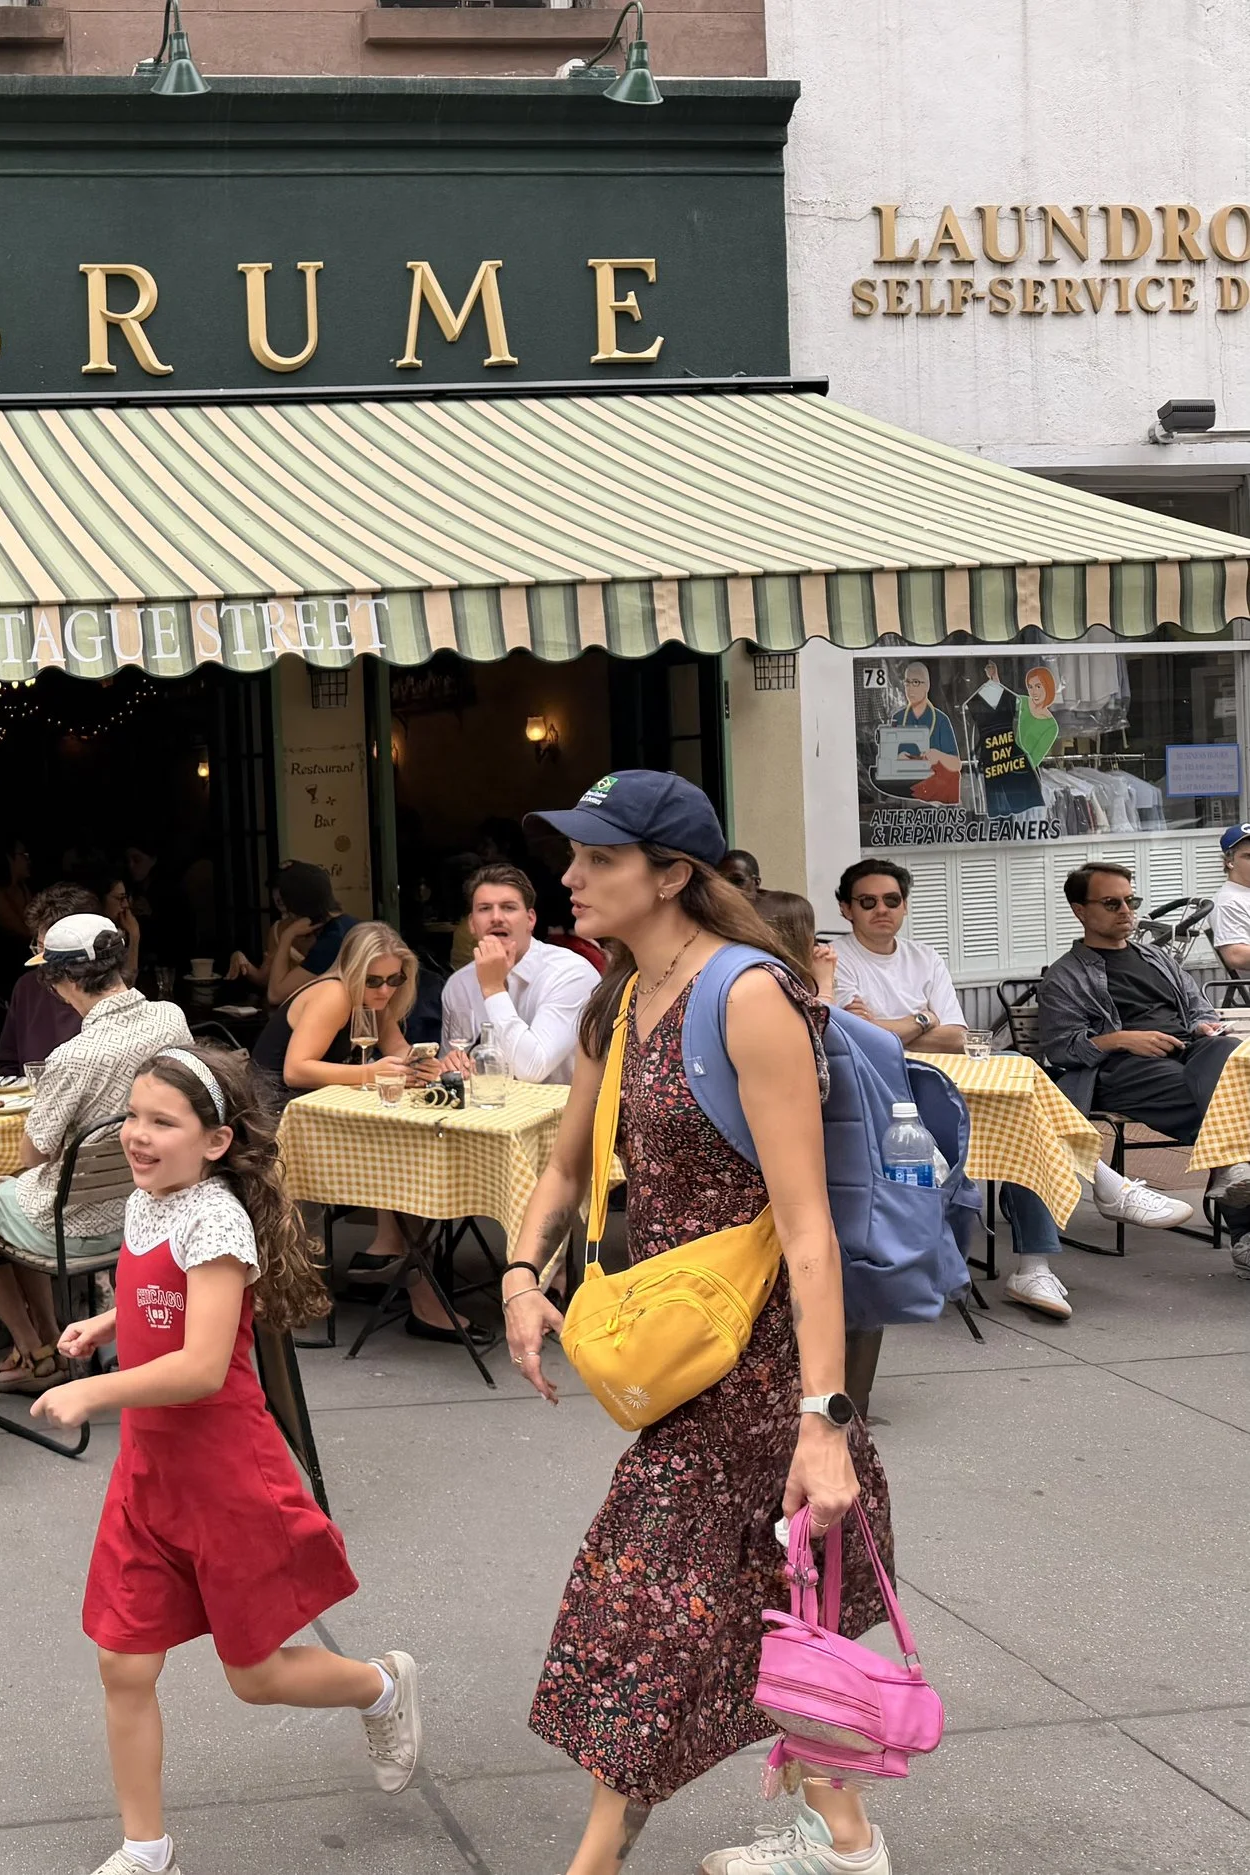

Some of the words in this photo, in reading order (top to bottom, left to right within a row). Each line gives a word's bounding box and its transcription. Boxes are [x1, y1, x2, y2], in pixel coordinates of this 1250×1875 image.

[871, 203, 1250, 264] LAUNDRO
[851, 275, 1198, 318] SELF-SERVICE
[192, 597, 393, 659] STREET
[864, 669, 886, 687] 78
[985, 731, 1014, 749] SAME
[992, 746, 1012, 762] DAY
[290, 761, 355, 776] Restaurant
[985, 757, 1025, 778] SERVICE
[314, 813, 337, 829] Bar
[870, 807, 966, 827] ALTERATIONS
[871, 826, 886, 846] &
[889, 823, 967, 845] REPAIRS
[965, 818, 1062, 843] CLEANERS
